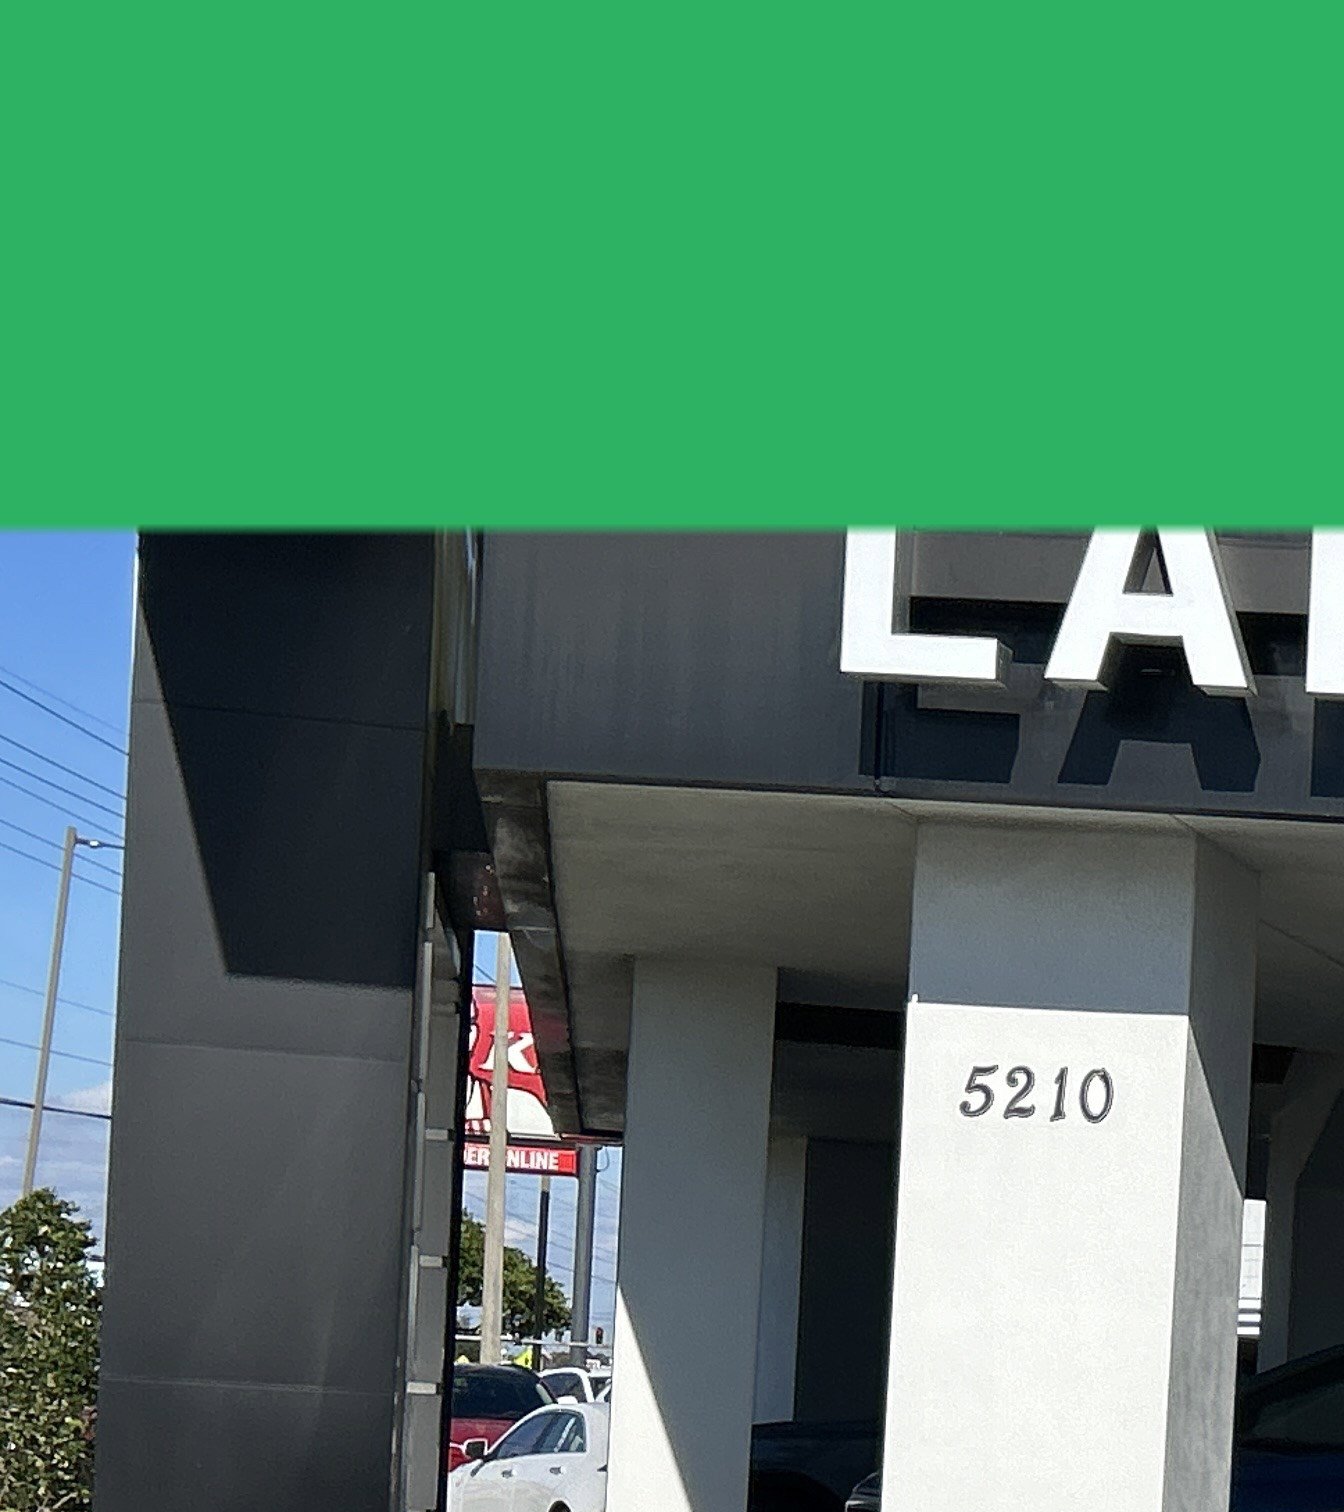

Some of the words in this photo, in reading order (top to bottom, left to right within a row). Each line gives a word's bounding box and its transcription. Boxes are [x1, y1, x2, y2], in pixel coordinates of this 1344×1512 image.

[959, 1064, 1114, 1124] 5210
[463, 1146, 490, 1166] ER
[506, 1149, 559, 1171] NLINE
